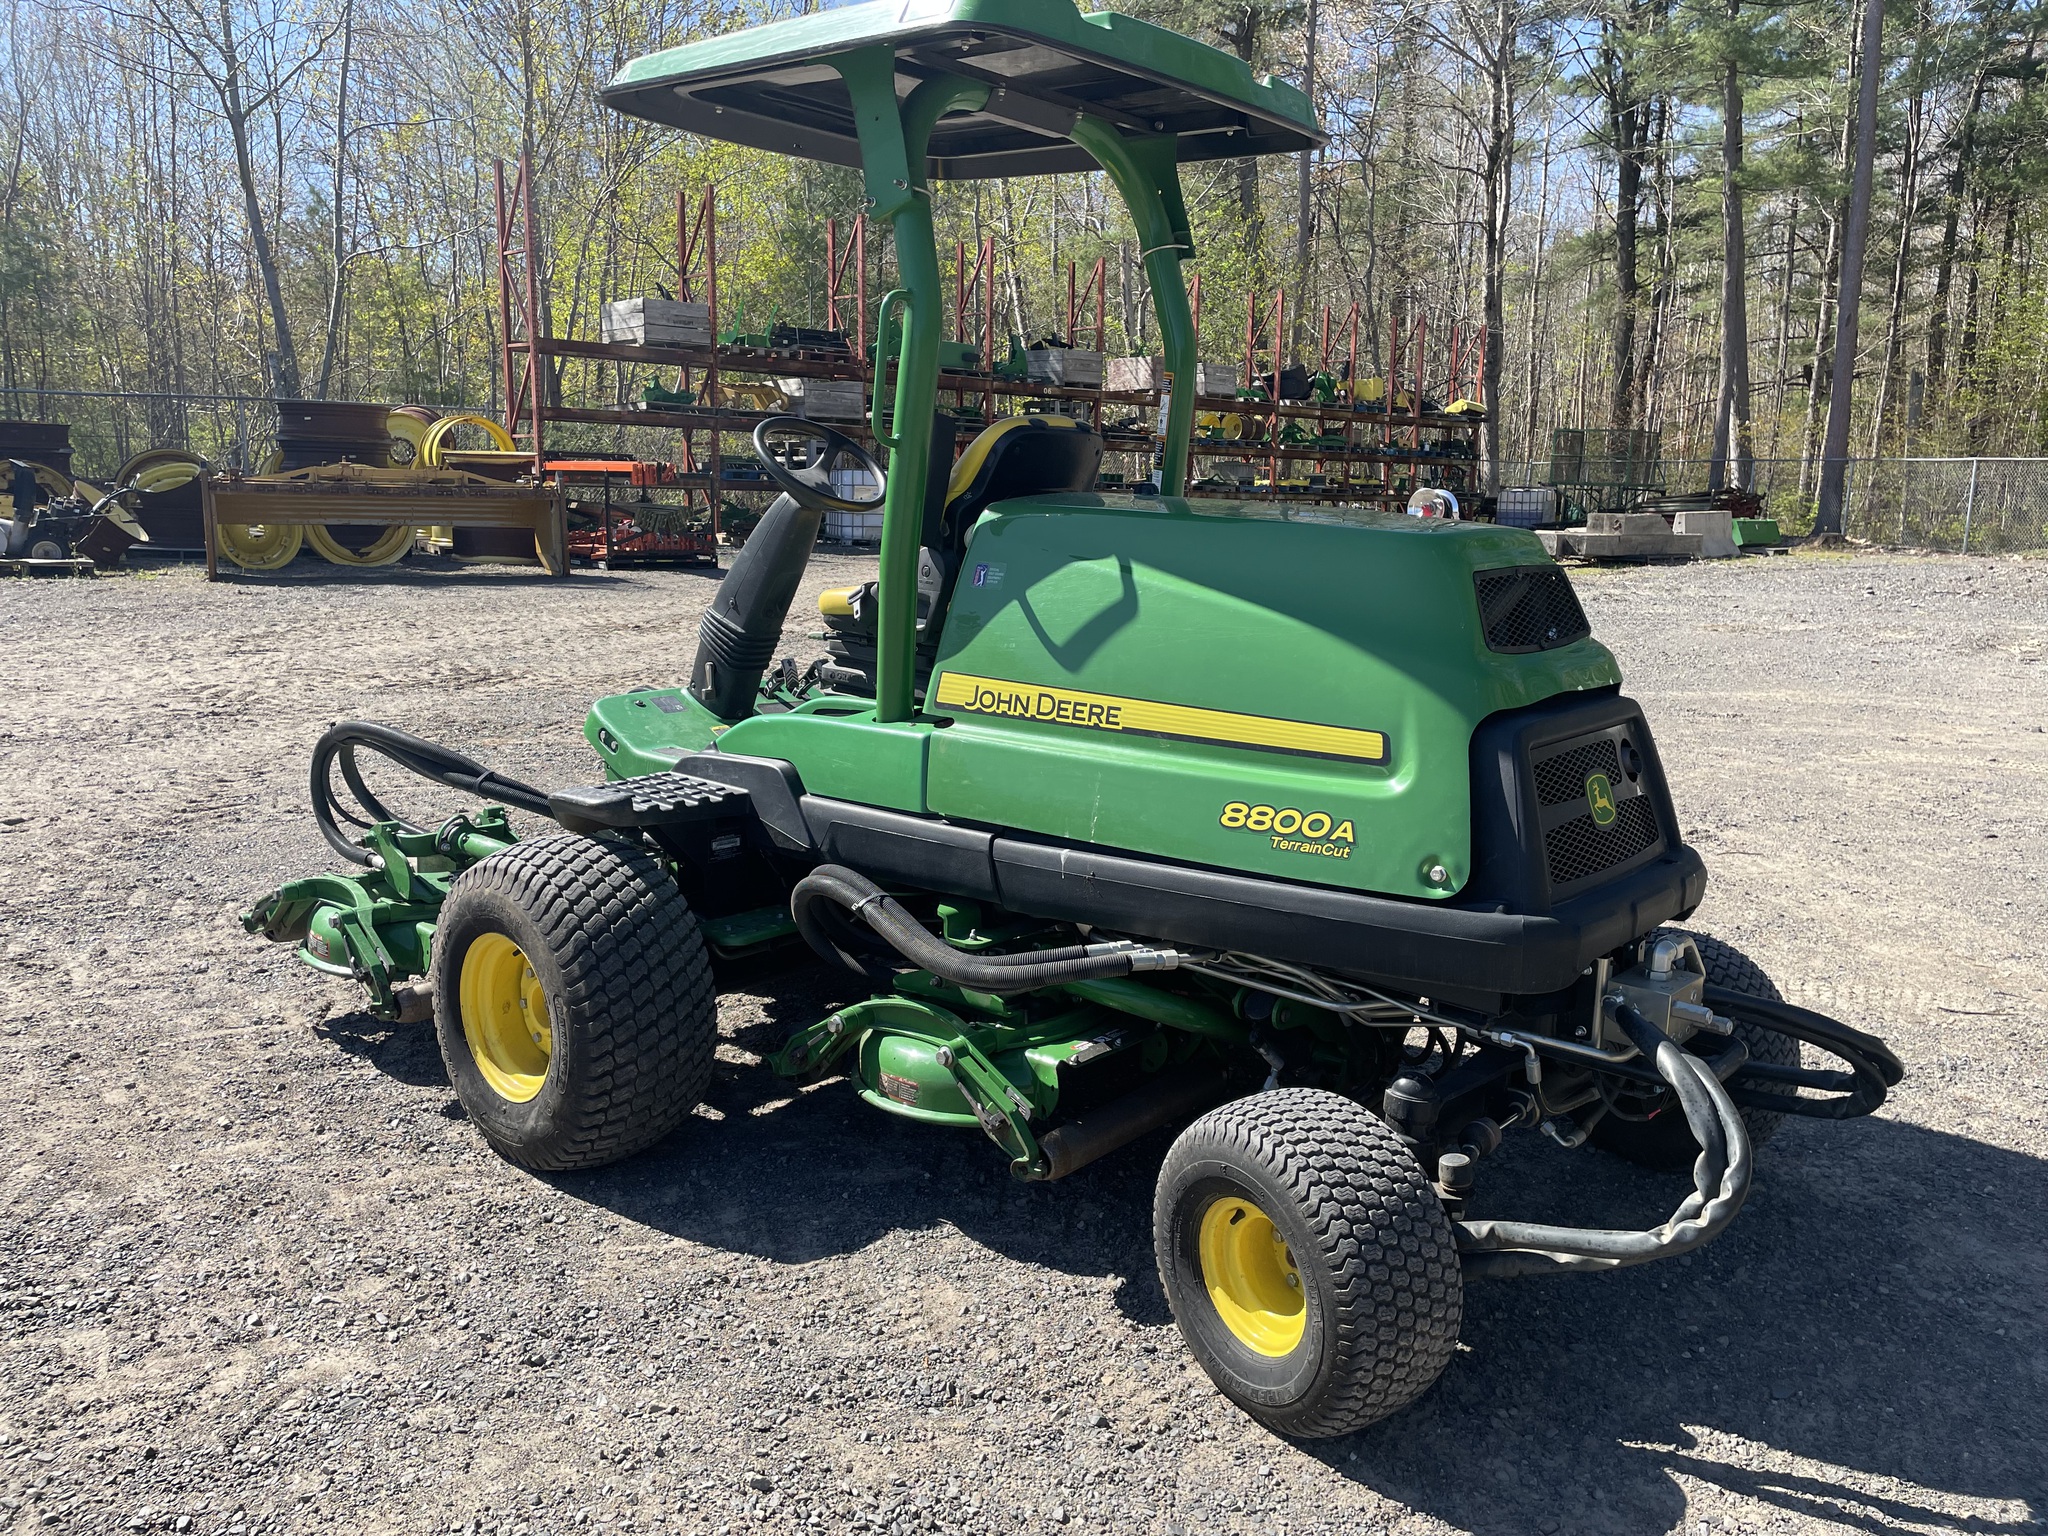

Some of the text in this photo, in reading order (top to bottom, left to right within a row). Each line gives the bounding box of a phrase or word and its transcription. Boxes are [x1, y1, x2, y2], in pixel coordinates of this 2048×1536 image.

[1043, 387, 1052, 395] 06
[964, 684, 1122, 728] JOHN DEERE
[1219, 801, 1356, 844] 8800A
[1270, 835, 1352, 859] TerrainCut
